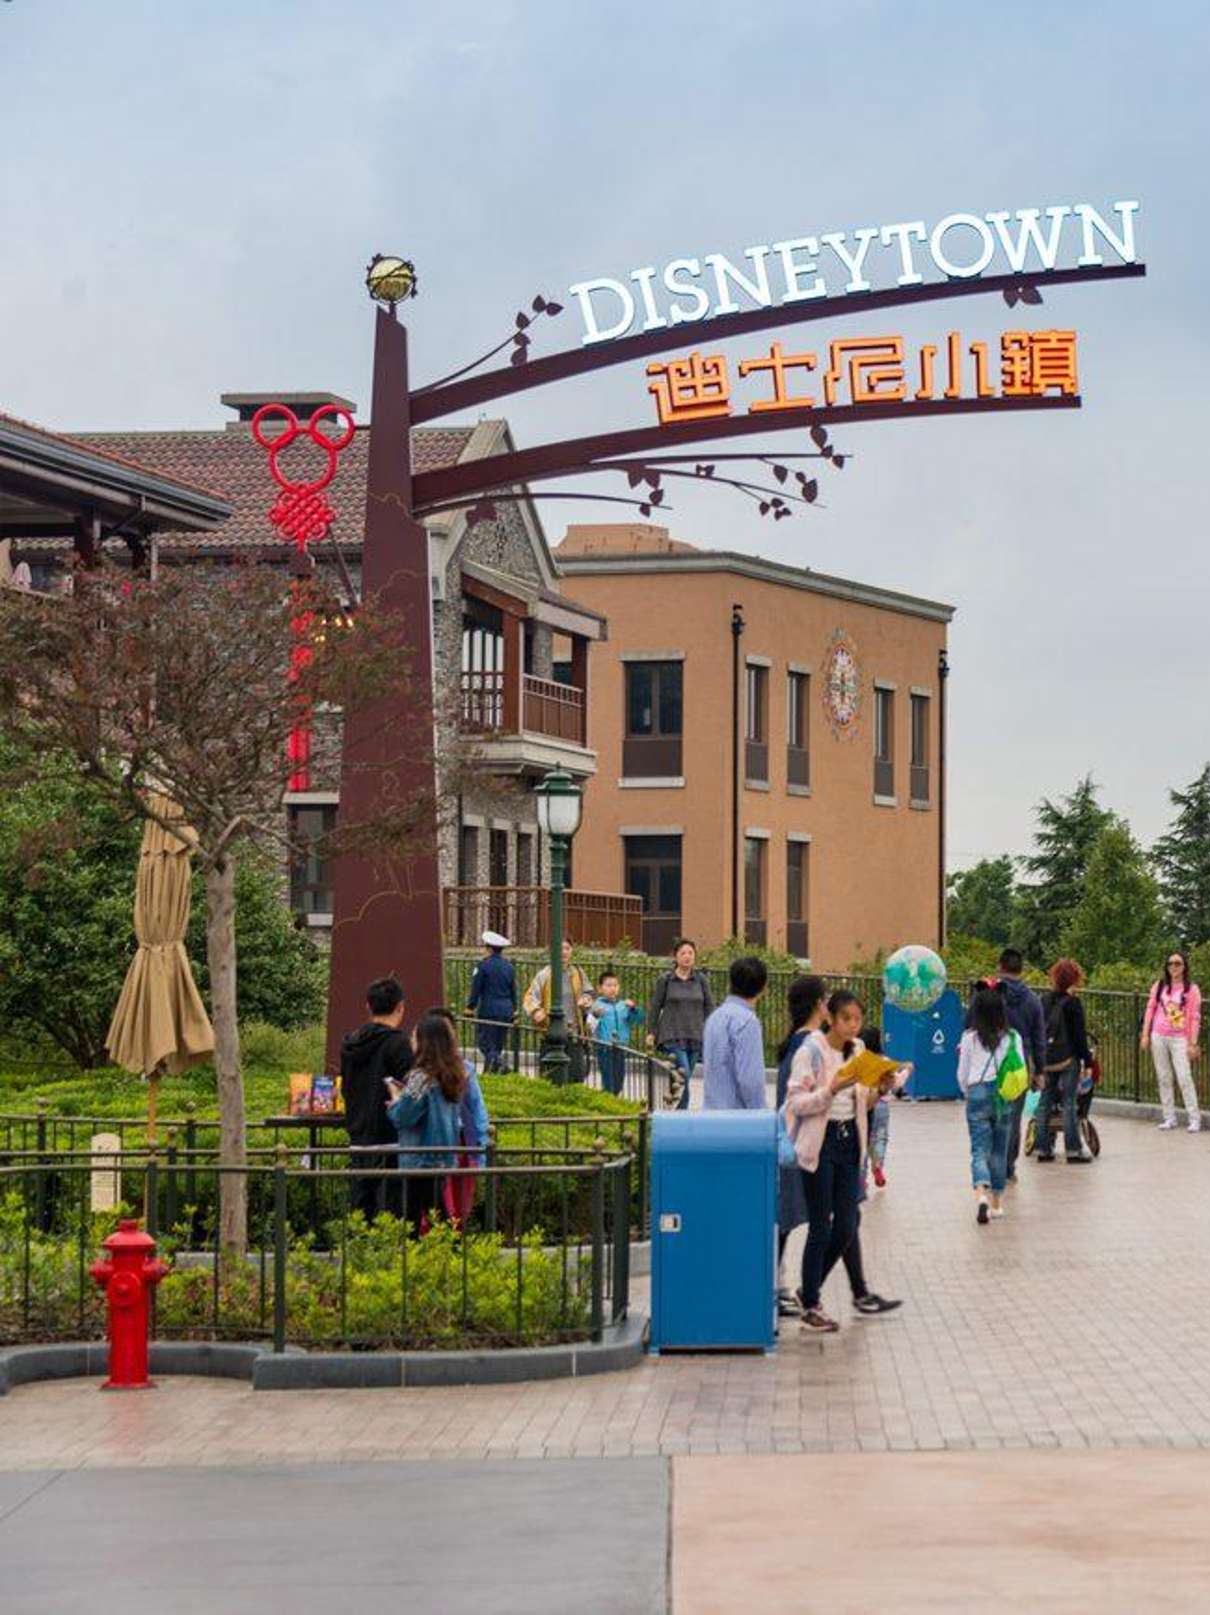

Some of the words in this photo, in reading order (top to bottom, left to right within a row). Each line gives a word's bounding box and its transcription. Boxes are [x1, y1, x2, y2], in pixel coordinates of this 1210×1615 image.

[568, 201, 1139, 345] DISNEYTOWN
[646, 329, 1080, 425] 迪士尼小鎮
